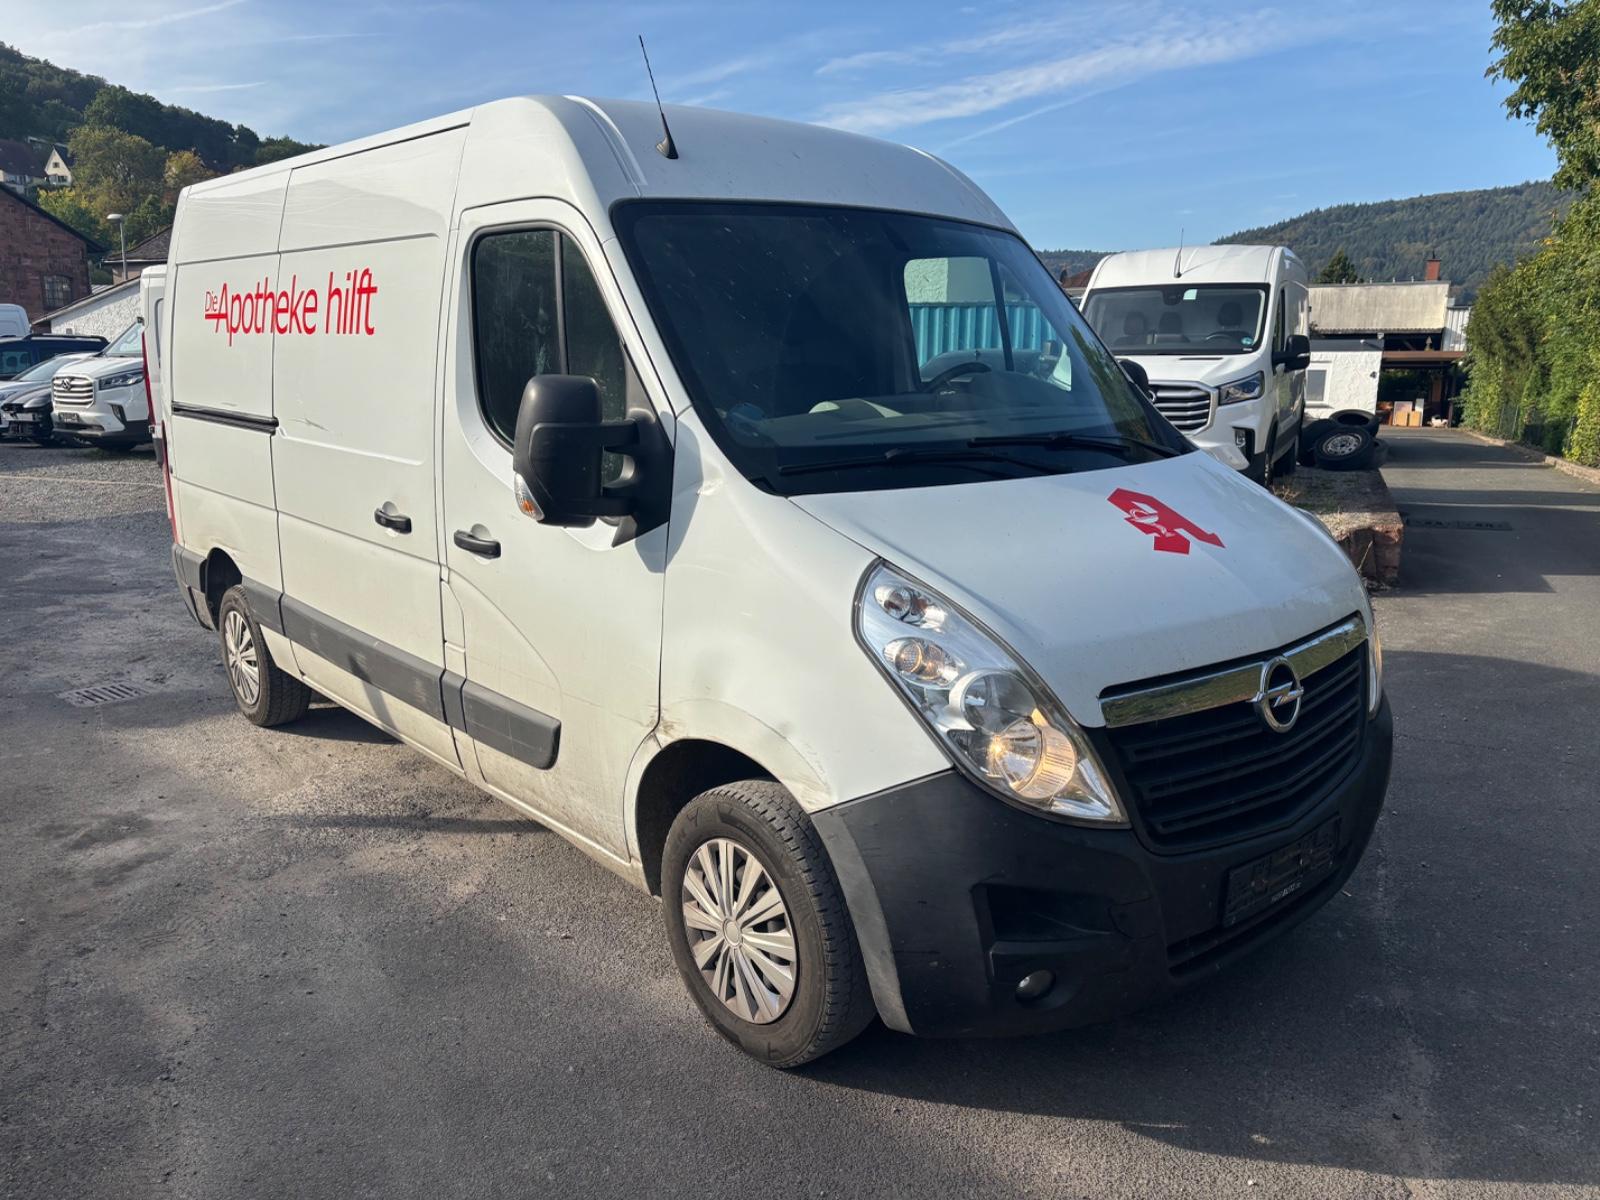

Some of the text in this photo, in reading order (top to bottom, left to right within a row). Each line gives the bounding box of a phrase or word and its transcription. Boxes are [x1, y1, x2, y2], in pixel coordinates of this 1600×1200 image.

[204, 267, 378, 346] Die Apotheke hilft
